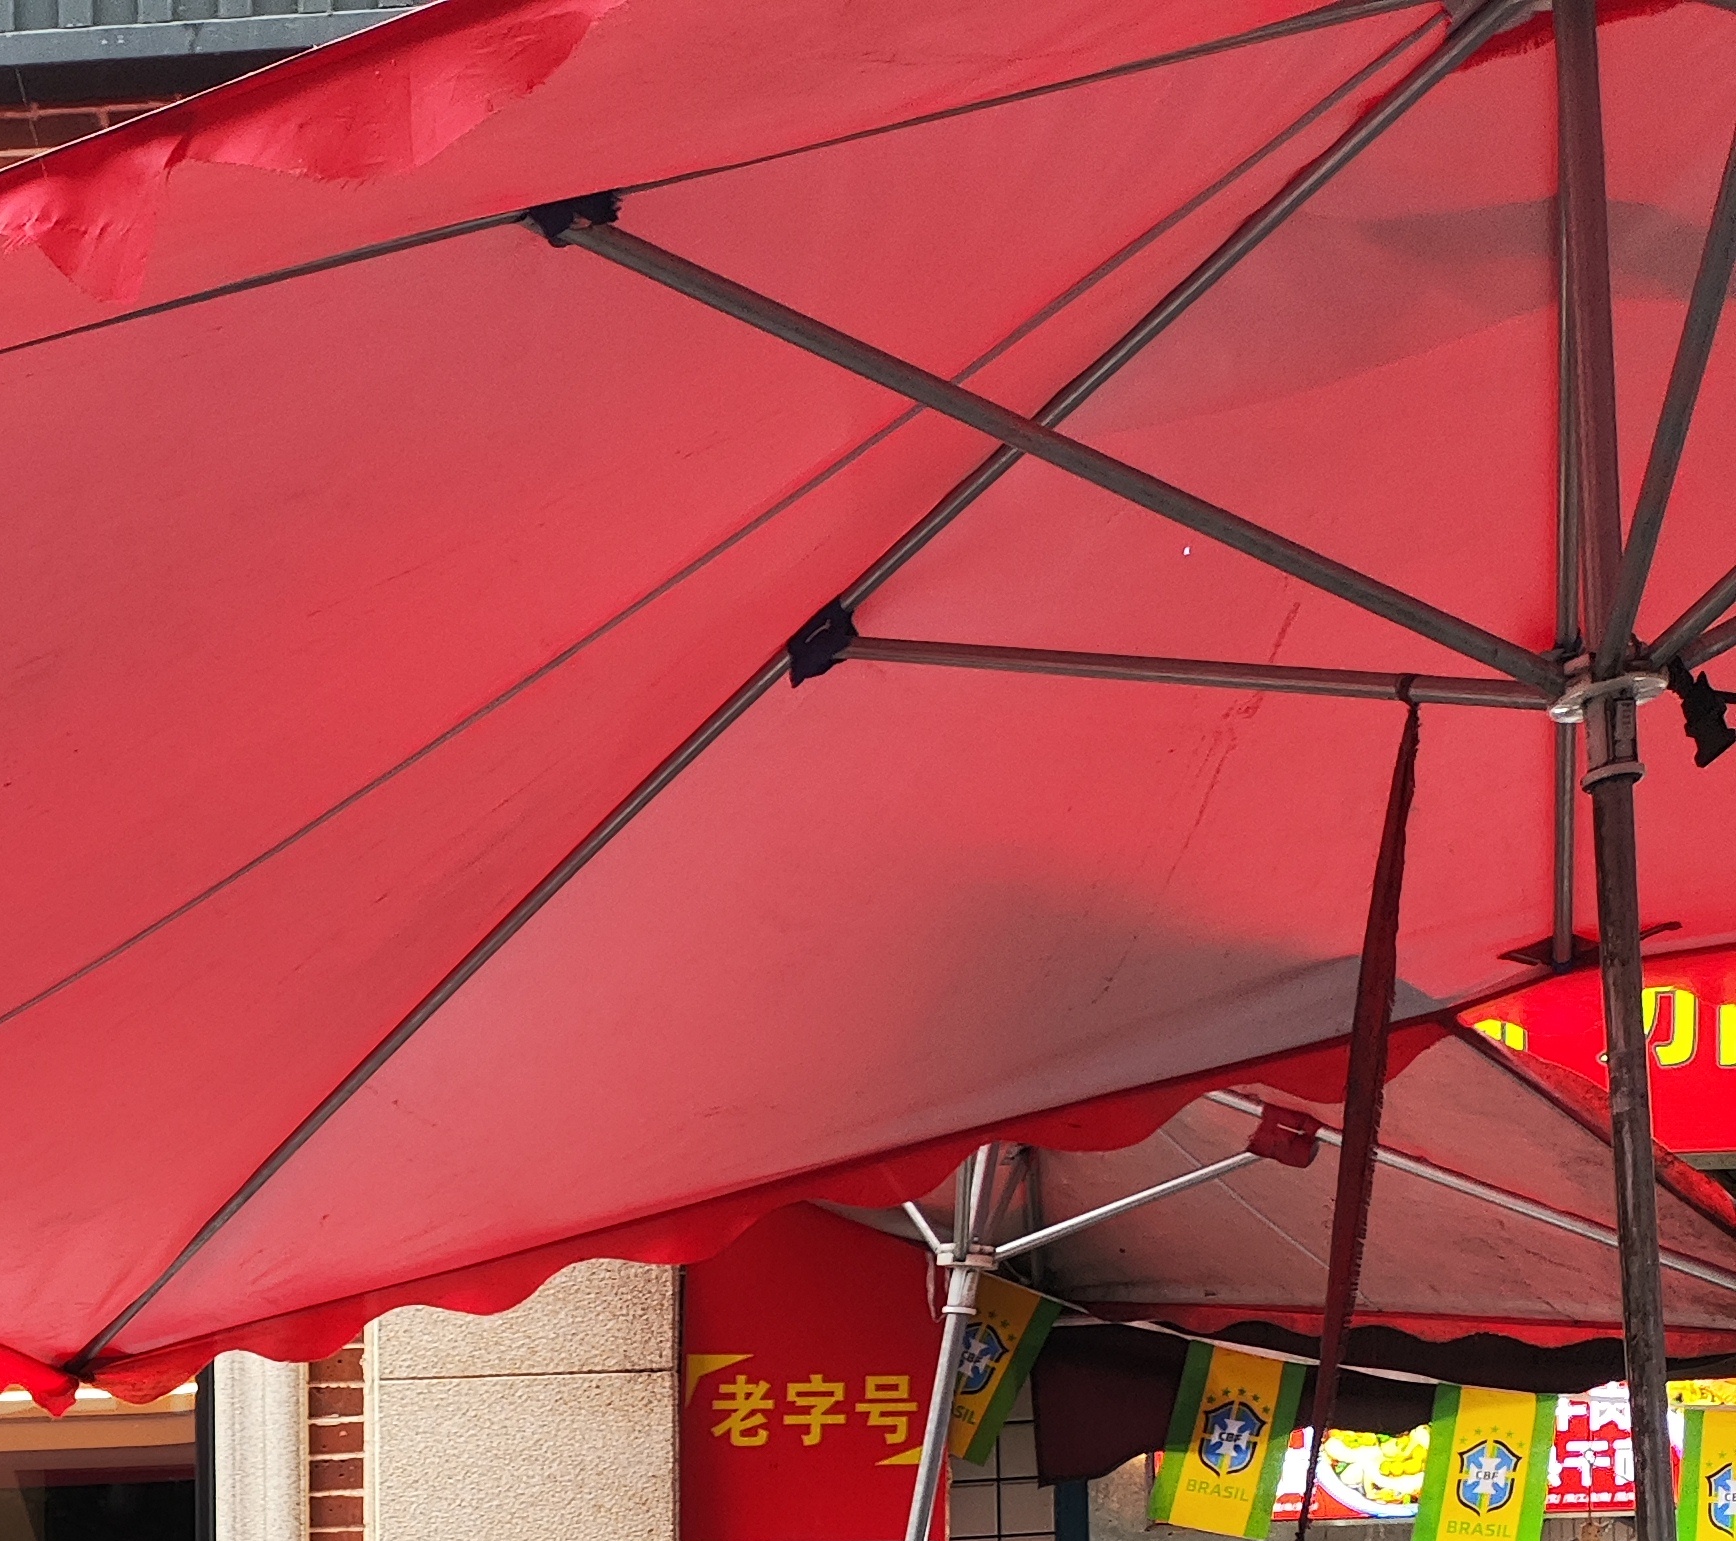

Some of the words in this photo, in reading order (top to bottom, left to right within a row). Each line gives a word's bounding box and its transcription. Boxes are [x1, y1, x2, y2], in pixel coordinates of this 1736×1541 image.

[711, 1374, 919, 1447] 老字号
[1218, 1431, 1243, 1443] CBF
[1474, 1469, 1499, 1481] CBF
[1185, 1478, 1250, 1502] BRASIL
[1446, 1520, 1512, 1538] BRASIL
